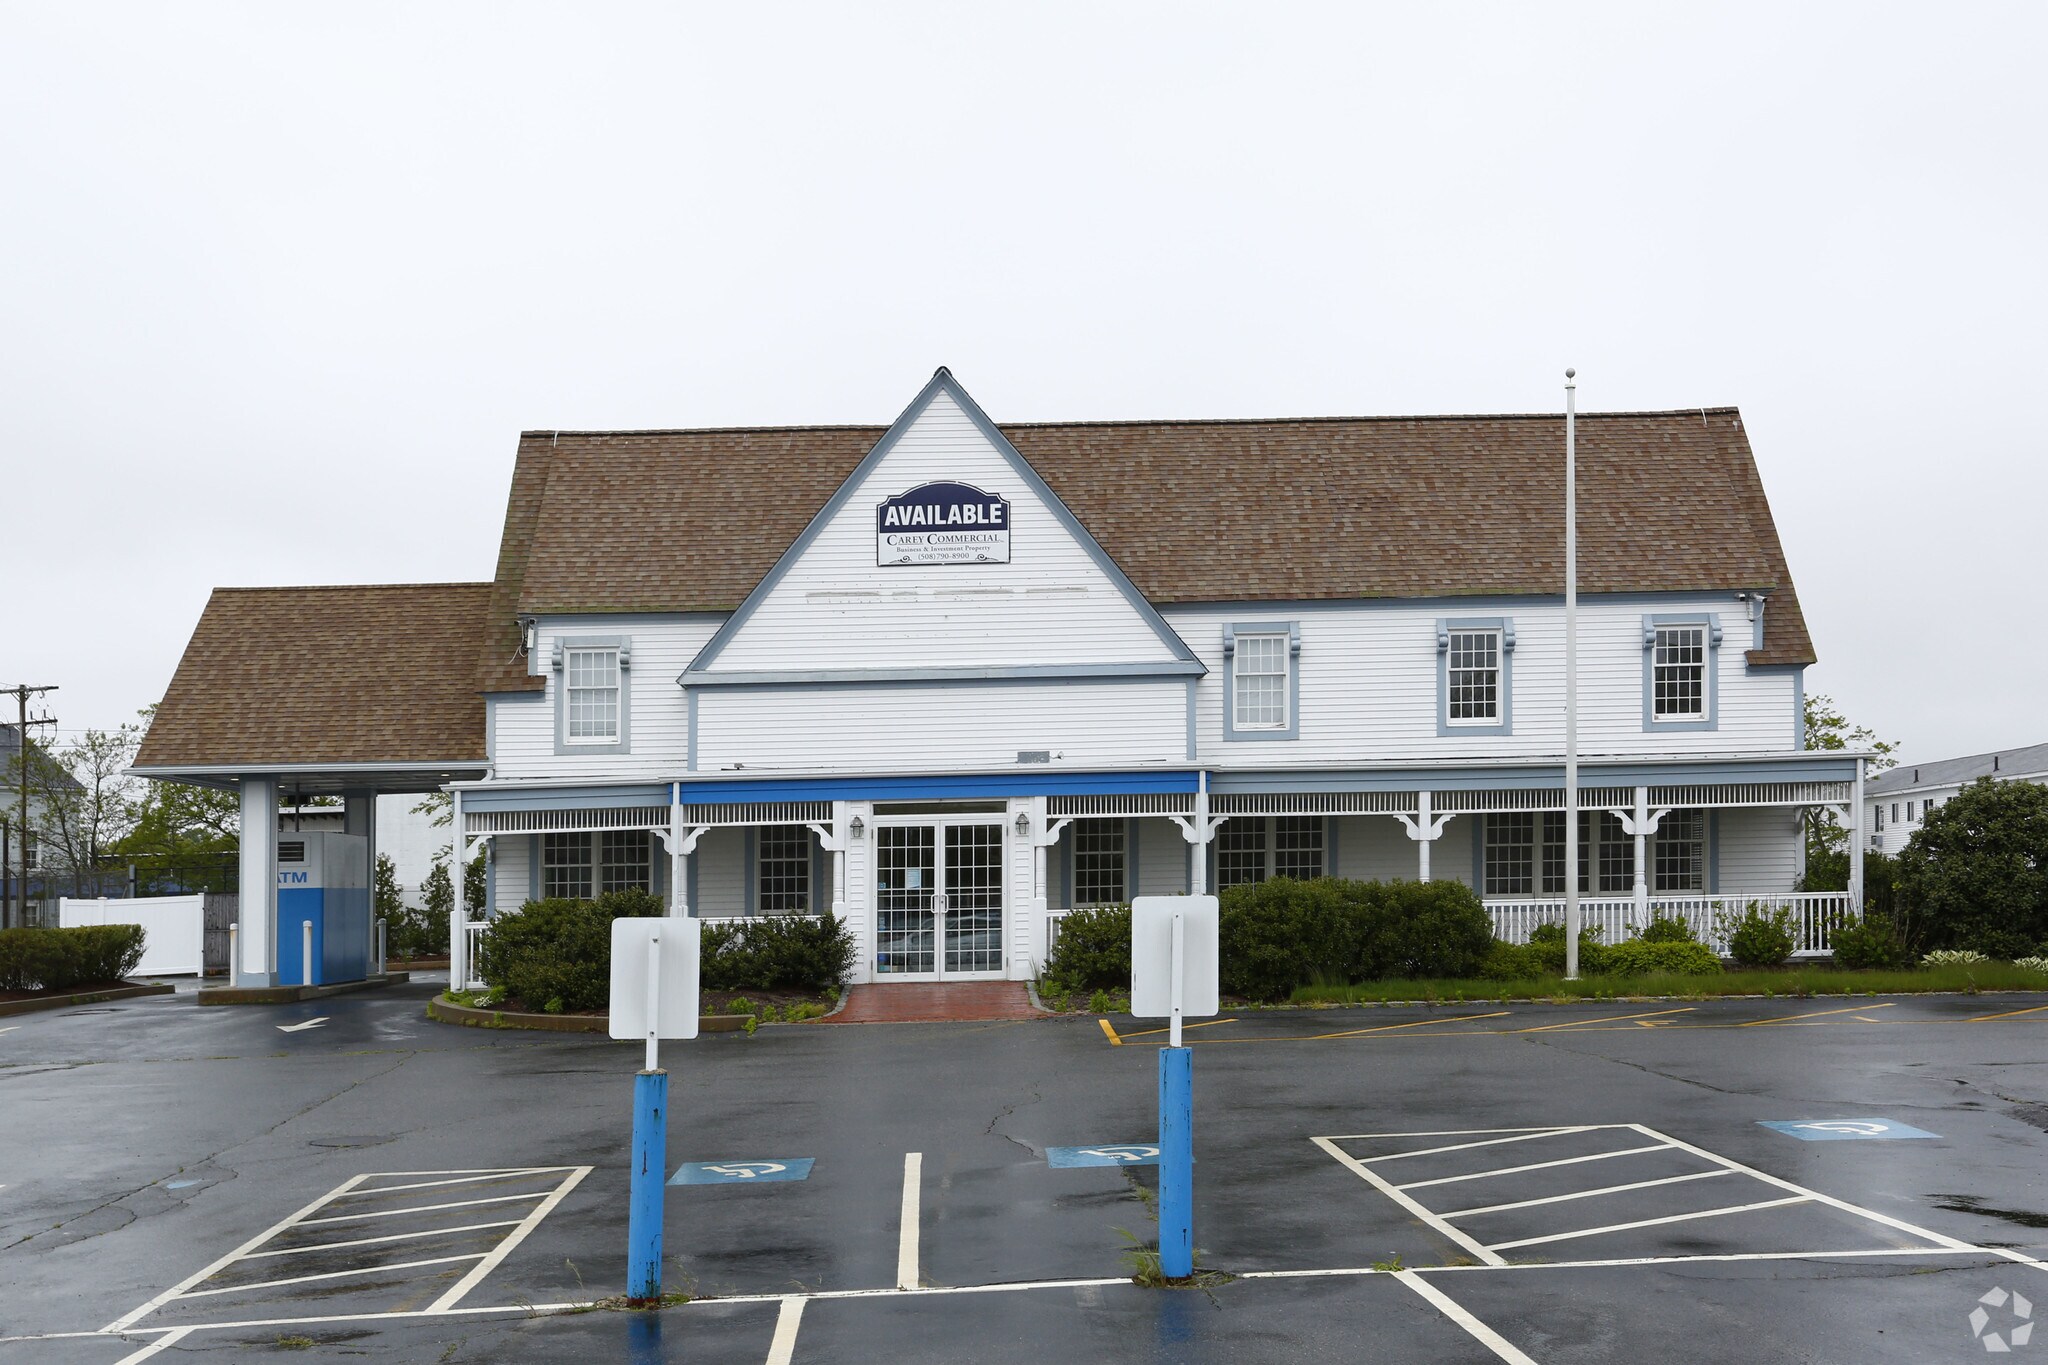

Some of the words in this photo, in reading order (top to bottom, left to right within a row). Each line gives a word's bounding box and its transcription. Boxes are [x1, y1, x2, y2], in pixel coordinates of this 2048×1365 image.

[884, 503, 1002, 527] AVAILABLE
[886, 534, 924, 546] CAREY
[927, 533, 1000, 545] COMMERCIAL
[965, 545, 991, 553] Property
